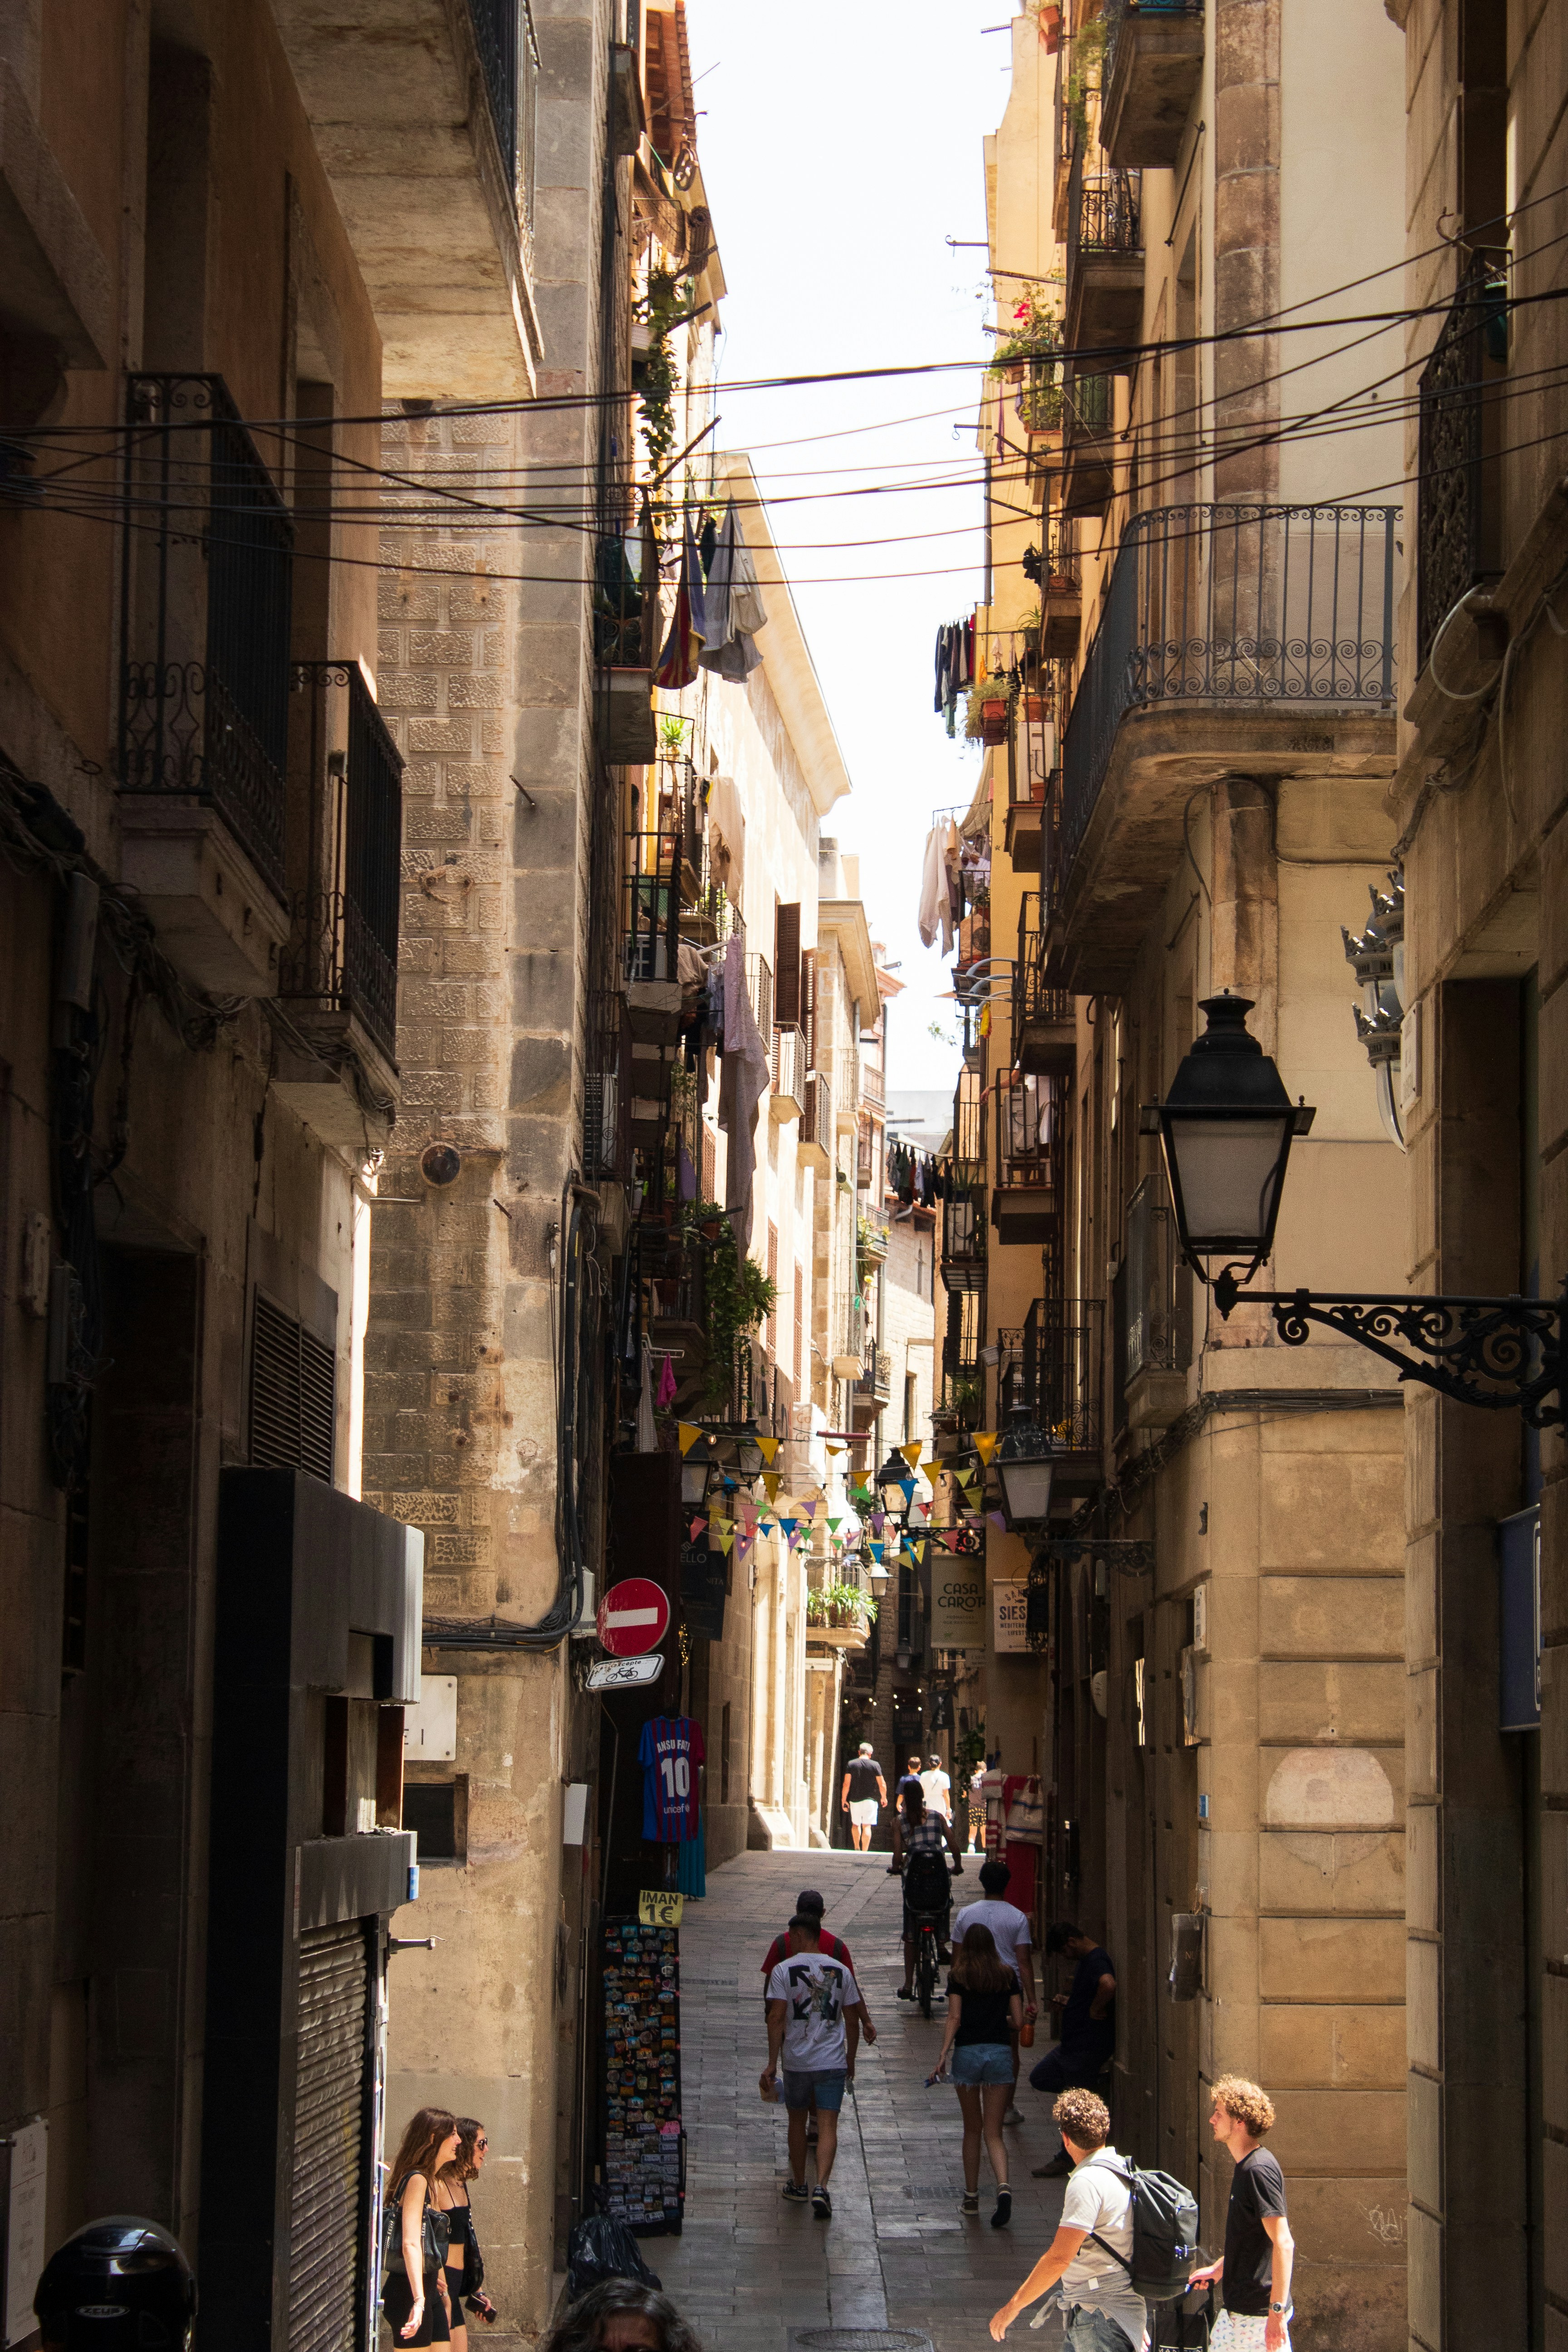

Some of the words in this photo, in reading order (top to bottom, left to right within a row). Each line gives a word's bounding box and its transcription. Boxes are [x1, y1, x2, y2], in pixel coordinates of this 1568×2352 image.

[943, 1583, 978, 1595] CASA
[1004, 1589, 1024, 1601] SAN
[1000, 1606, 1026, 1620] SIES
[657, 1740, 676, 1753] ANSU
[677, 1740, 690, 1752] FATI
[661, 1757, 690, 1798] 10
[664, 1803, 685, 1814] unicef
[642, 1891, 678, 1906] IMAN
